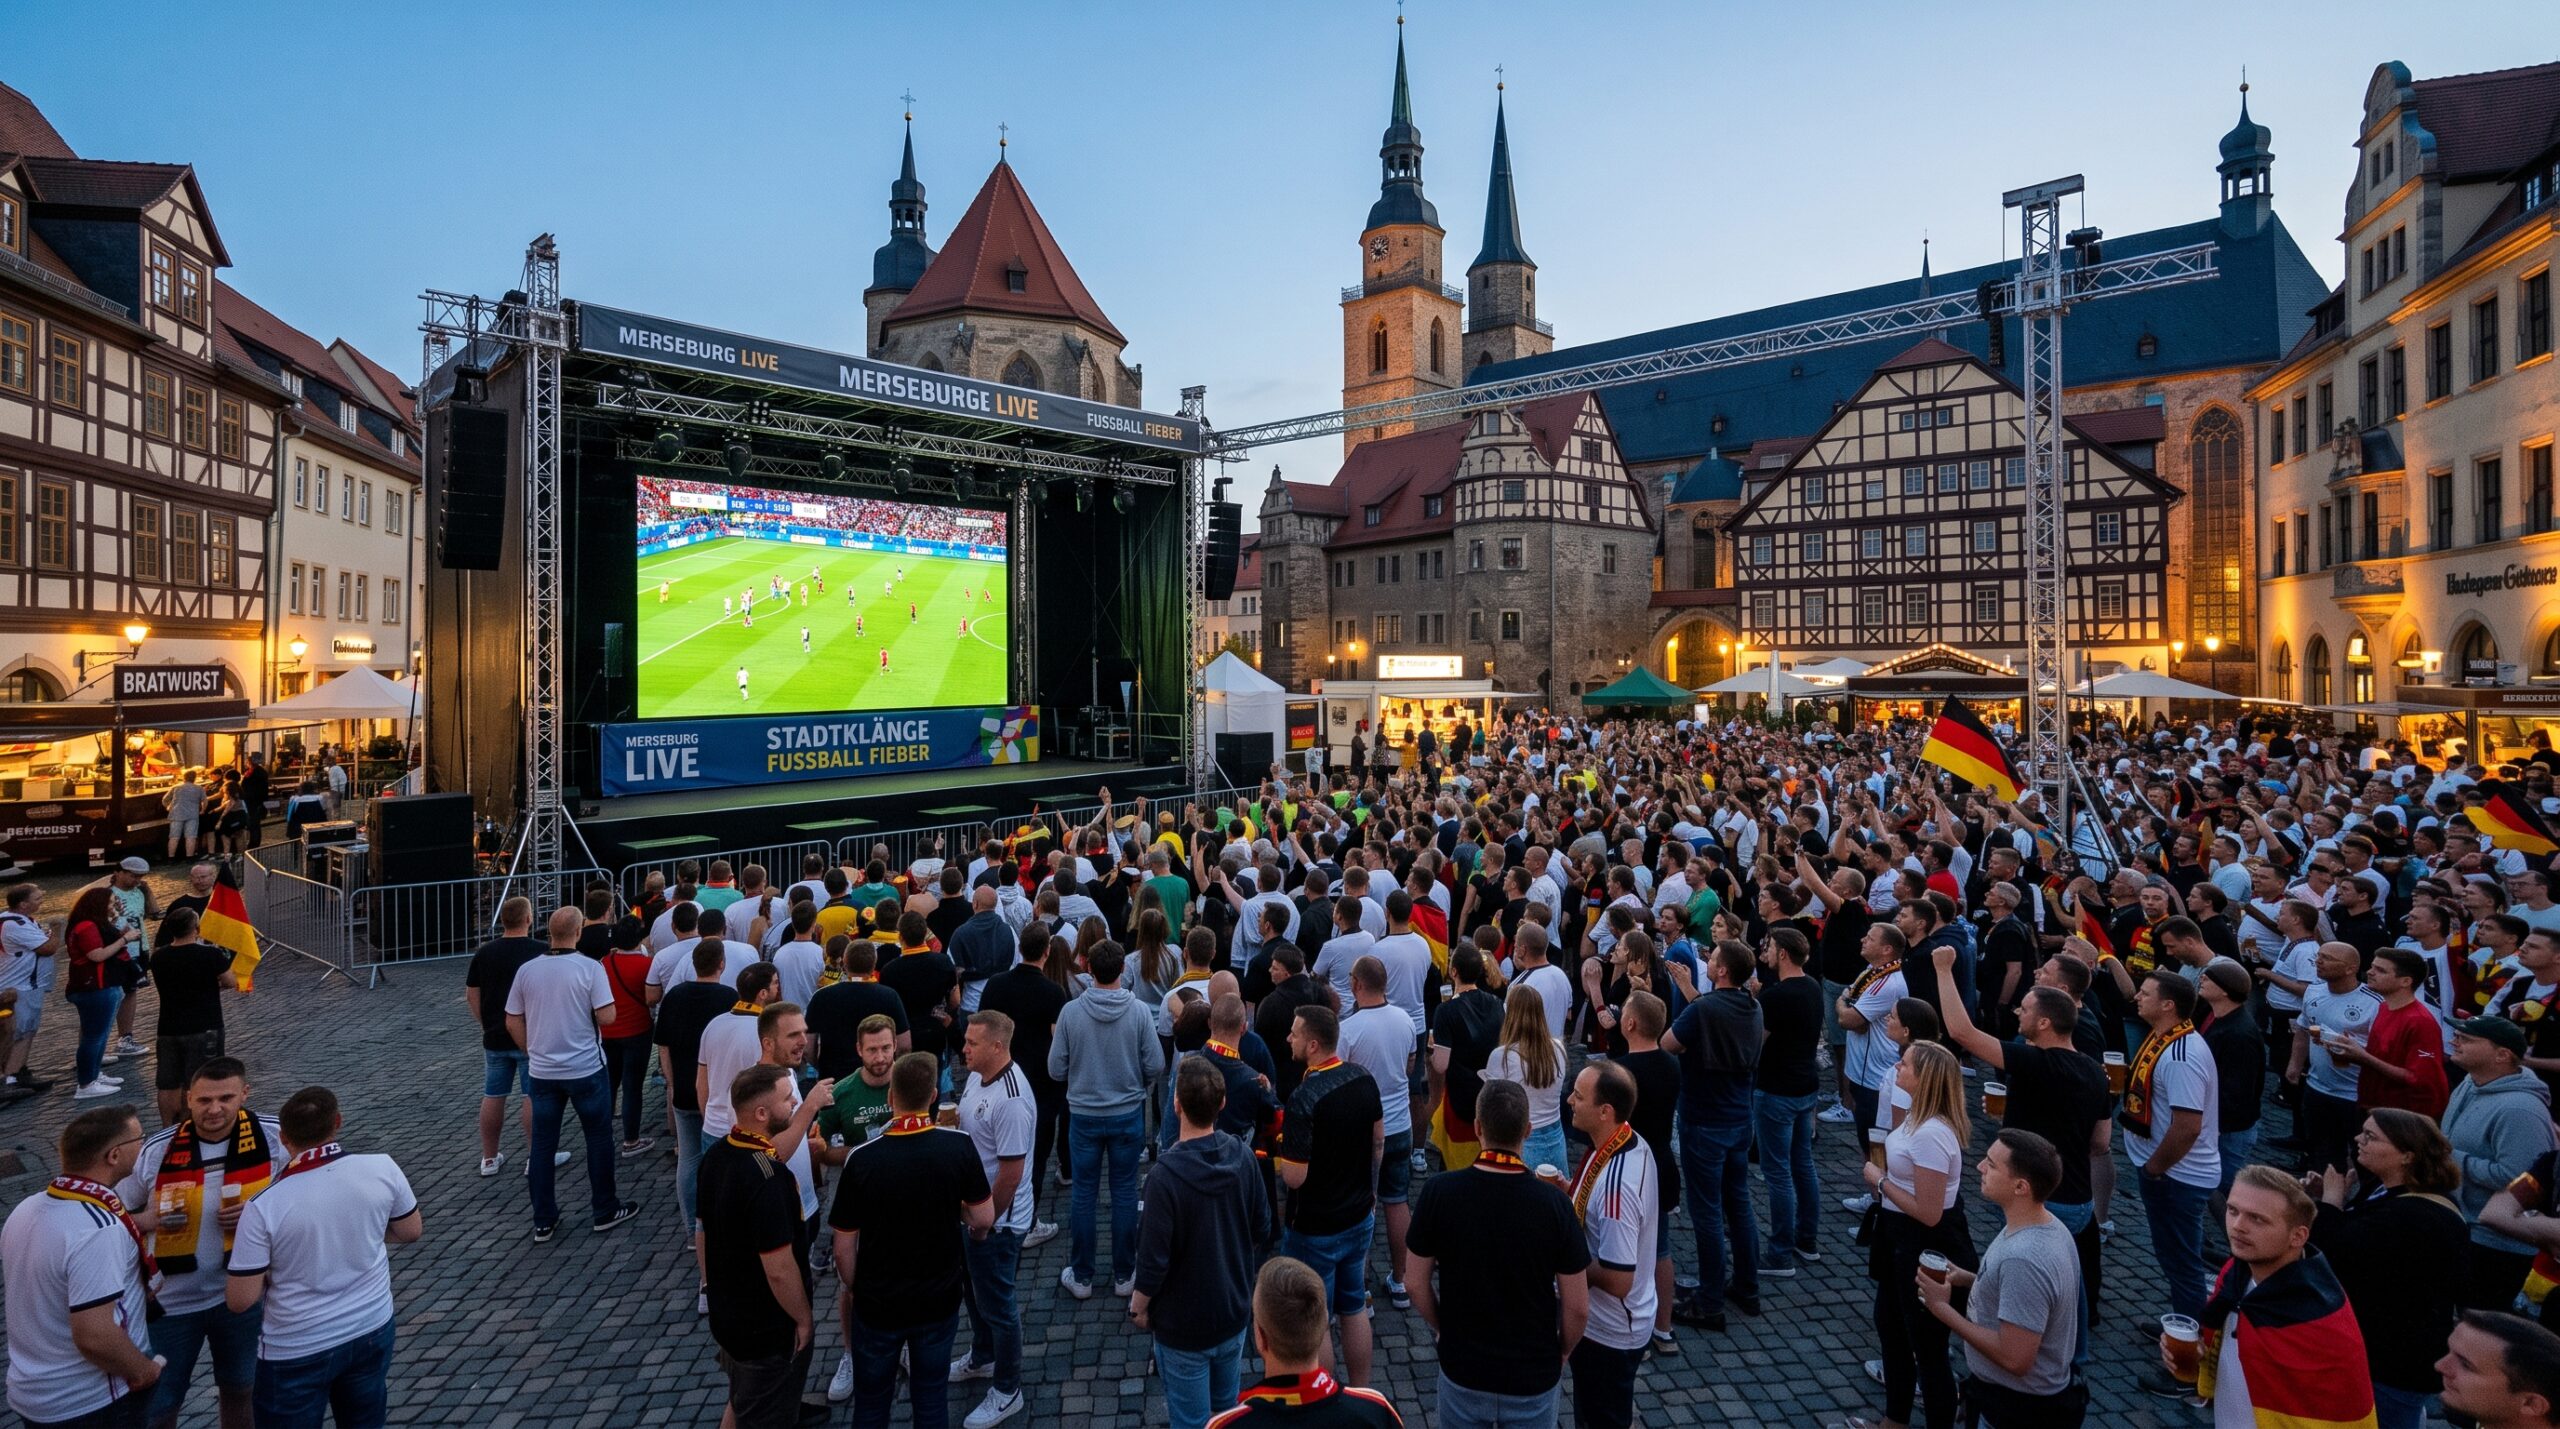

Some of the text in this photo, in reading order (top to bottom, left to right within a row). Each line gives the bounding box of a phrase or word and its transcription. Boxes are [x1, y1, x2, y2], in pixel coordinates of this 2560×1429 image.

[619, 326, 779, 372] MERSEBURG LIVE
[839, 365, 1039, 421] MERSEBURGE LIVE
[1086, 412, 1182, 441] FUSSBALL FIEBER
[123, 671, 220, 693] BRATWURST
[625, 733, 699, 748] MERSEBURG
[766, 716, 930, 750] STADTKLÄNGE
[626, 748, 700, 783] LIVE
[767, 744, 930, 773] FUSSBALL FIEBER
